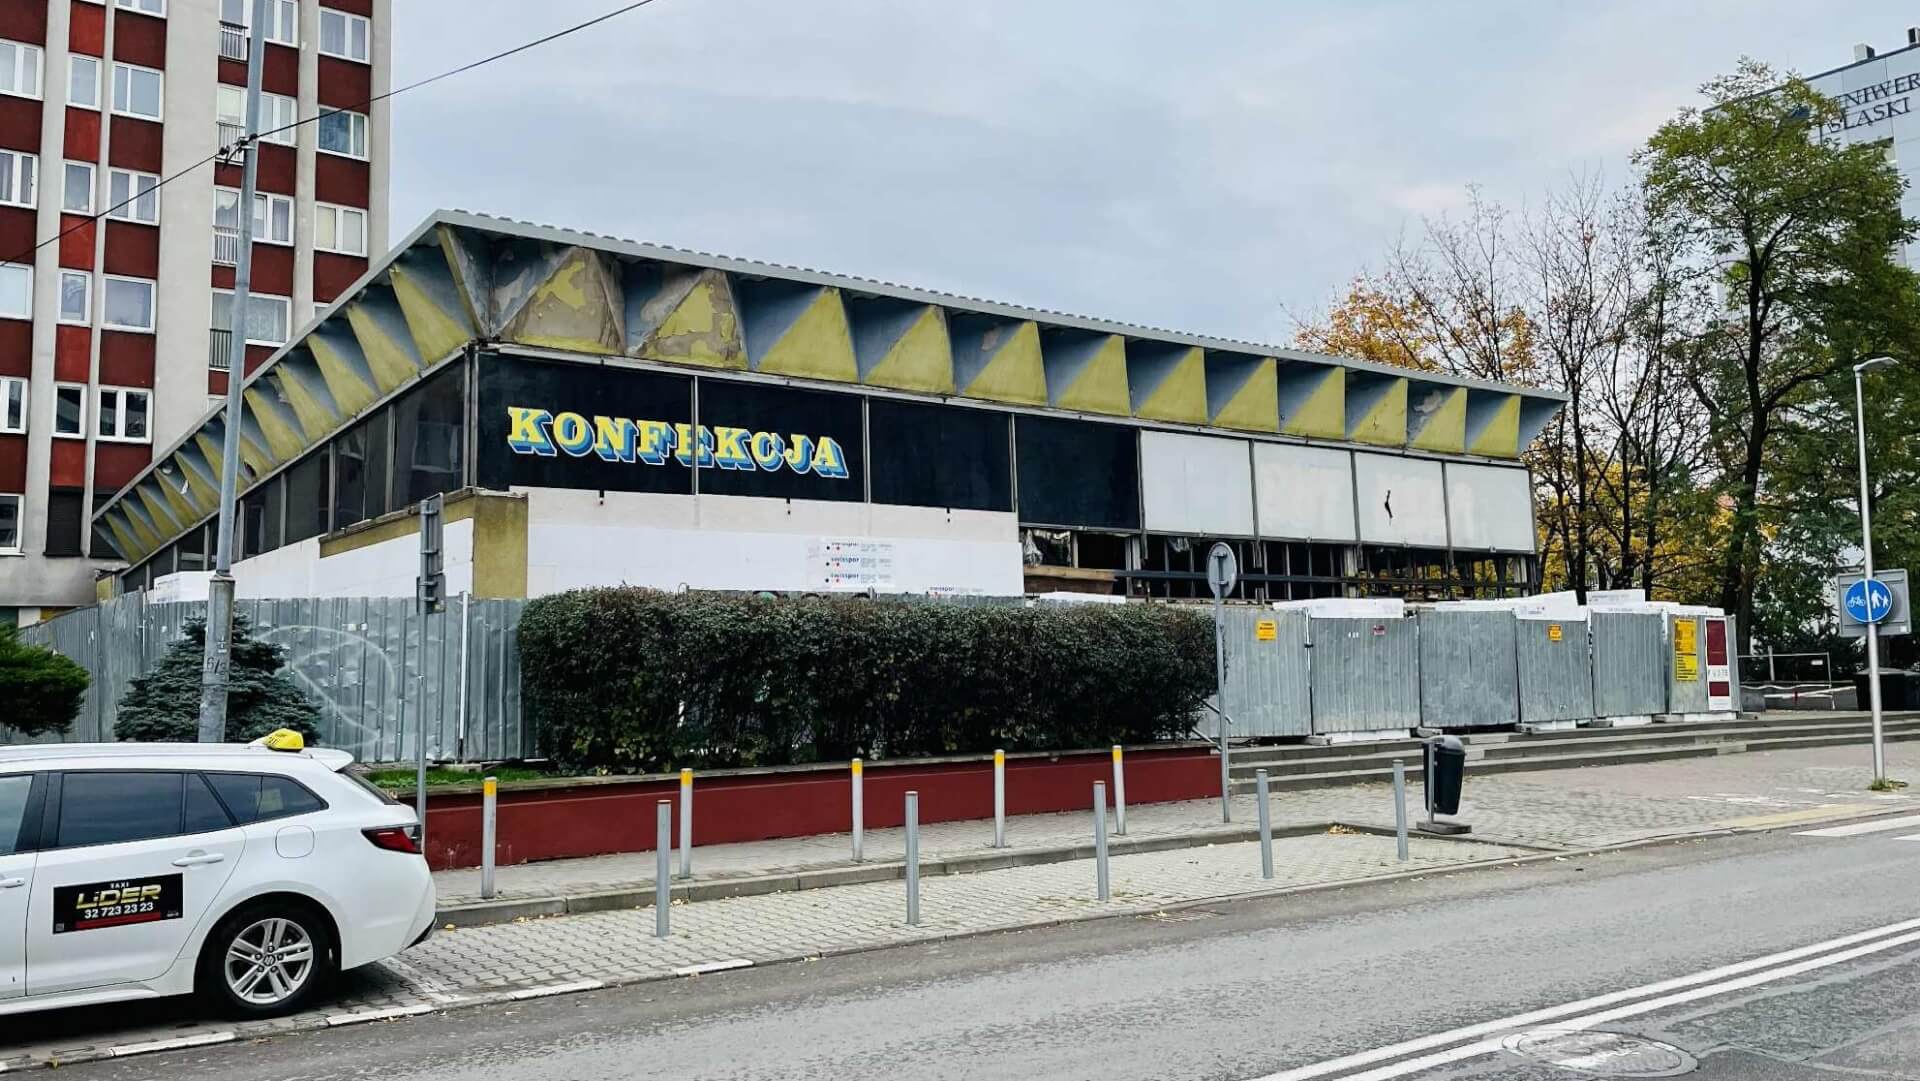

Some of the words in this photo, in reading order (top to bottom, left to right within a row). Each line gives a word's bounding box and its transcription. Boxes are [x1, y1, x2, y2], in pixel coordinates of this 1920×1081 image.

[1835, 73, 1920, 108] NIWER
[507, 405, 849, 479] KONFEKCJA
[109, 881, 130, 890] TAXI
[84, 909, 99, 919] 32
[101, 905, 122, 917] 723
[123, 904, 138, 914] 23
[139, 902, 154, 912] 23
